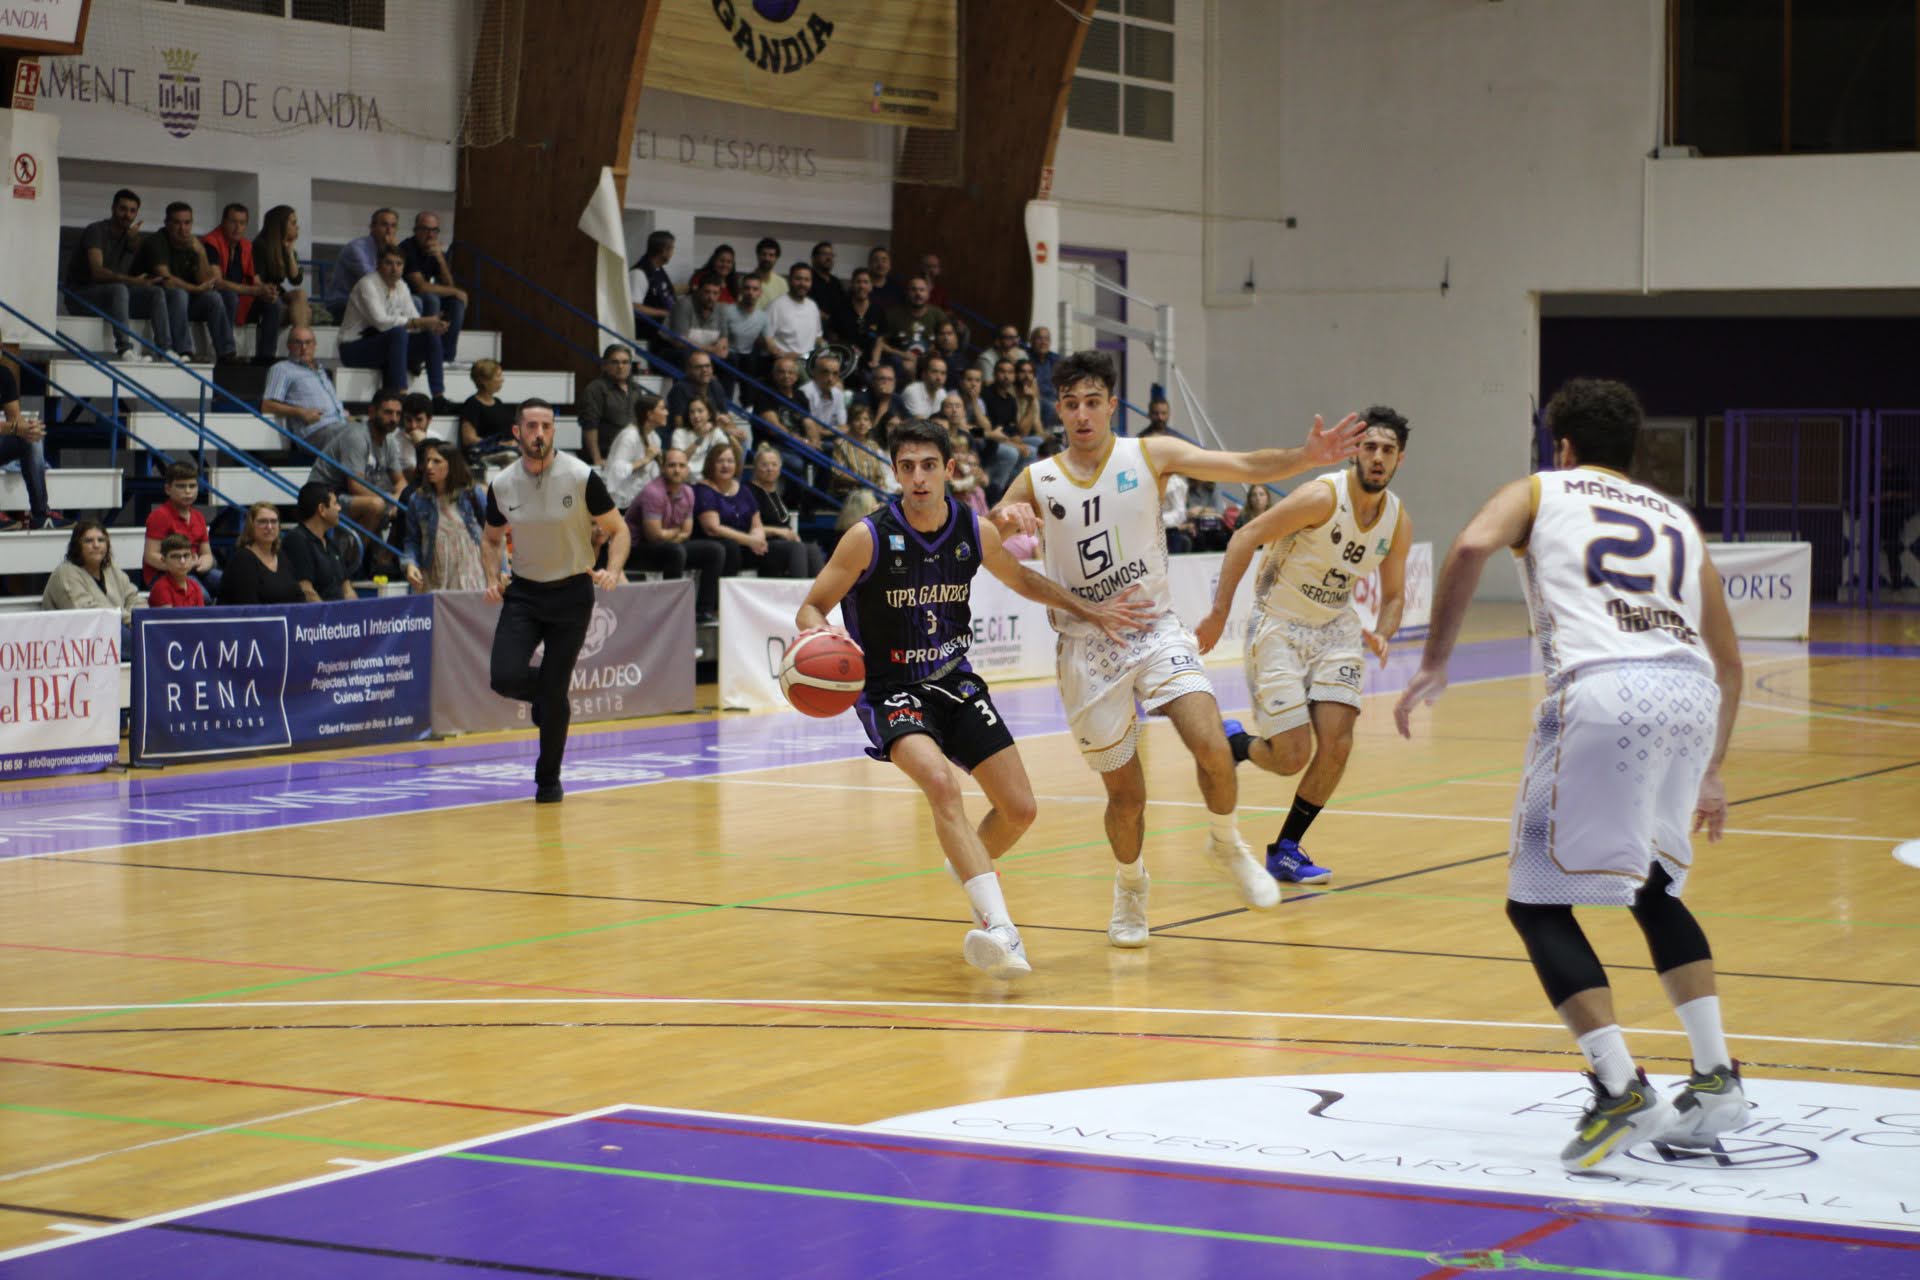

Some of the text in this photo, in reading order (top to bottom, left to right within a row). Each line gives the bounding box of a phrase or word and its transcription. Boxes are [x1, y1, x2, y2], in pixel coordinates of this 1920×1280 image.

[222, 79, 258, 120] DE
[272, 85, 383, 132] GANDIA
[1082, 495, 1100, 527] 11
[1564, 480, 1678, 519] MARMOL
[1342, 541, 1366, 564] 88
[1585, 504, 1685, 604] 21
[886, 588, 917, 608] UPB
[295, 624, 361, 645] Arquitectura
[370, 615, 431, 635] Interiorisme
[926, 609, 938, 635] 3
[350, 656, 384, 669] reforma
[385, 652, 411, 667] integral
[311, 676, 347, 691] Projectes
[348, 671, 385, 687] integrals
[28, 672, 91, 722] REG
[333, 691, 364, 704] Cuines
[170, 717, 264, 733] INTERIORS
[974, 699, 998, 727] 3
[951, 1117, 1536, 1177] CONCESIONARIO
[1565, 1172, 1852, 1209] OFICIAL
